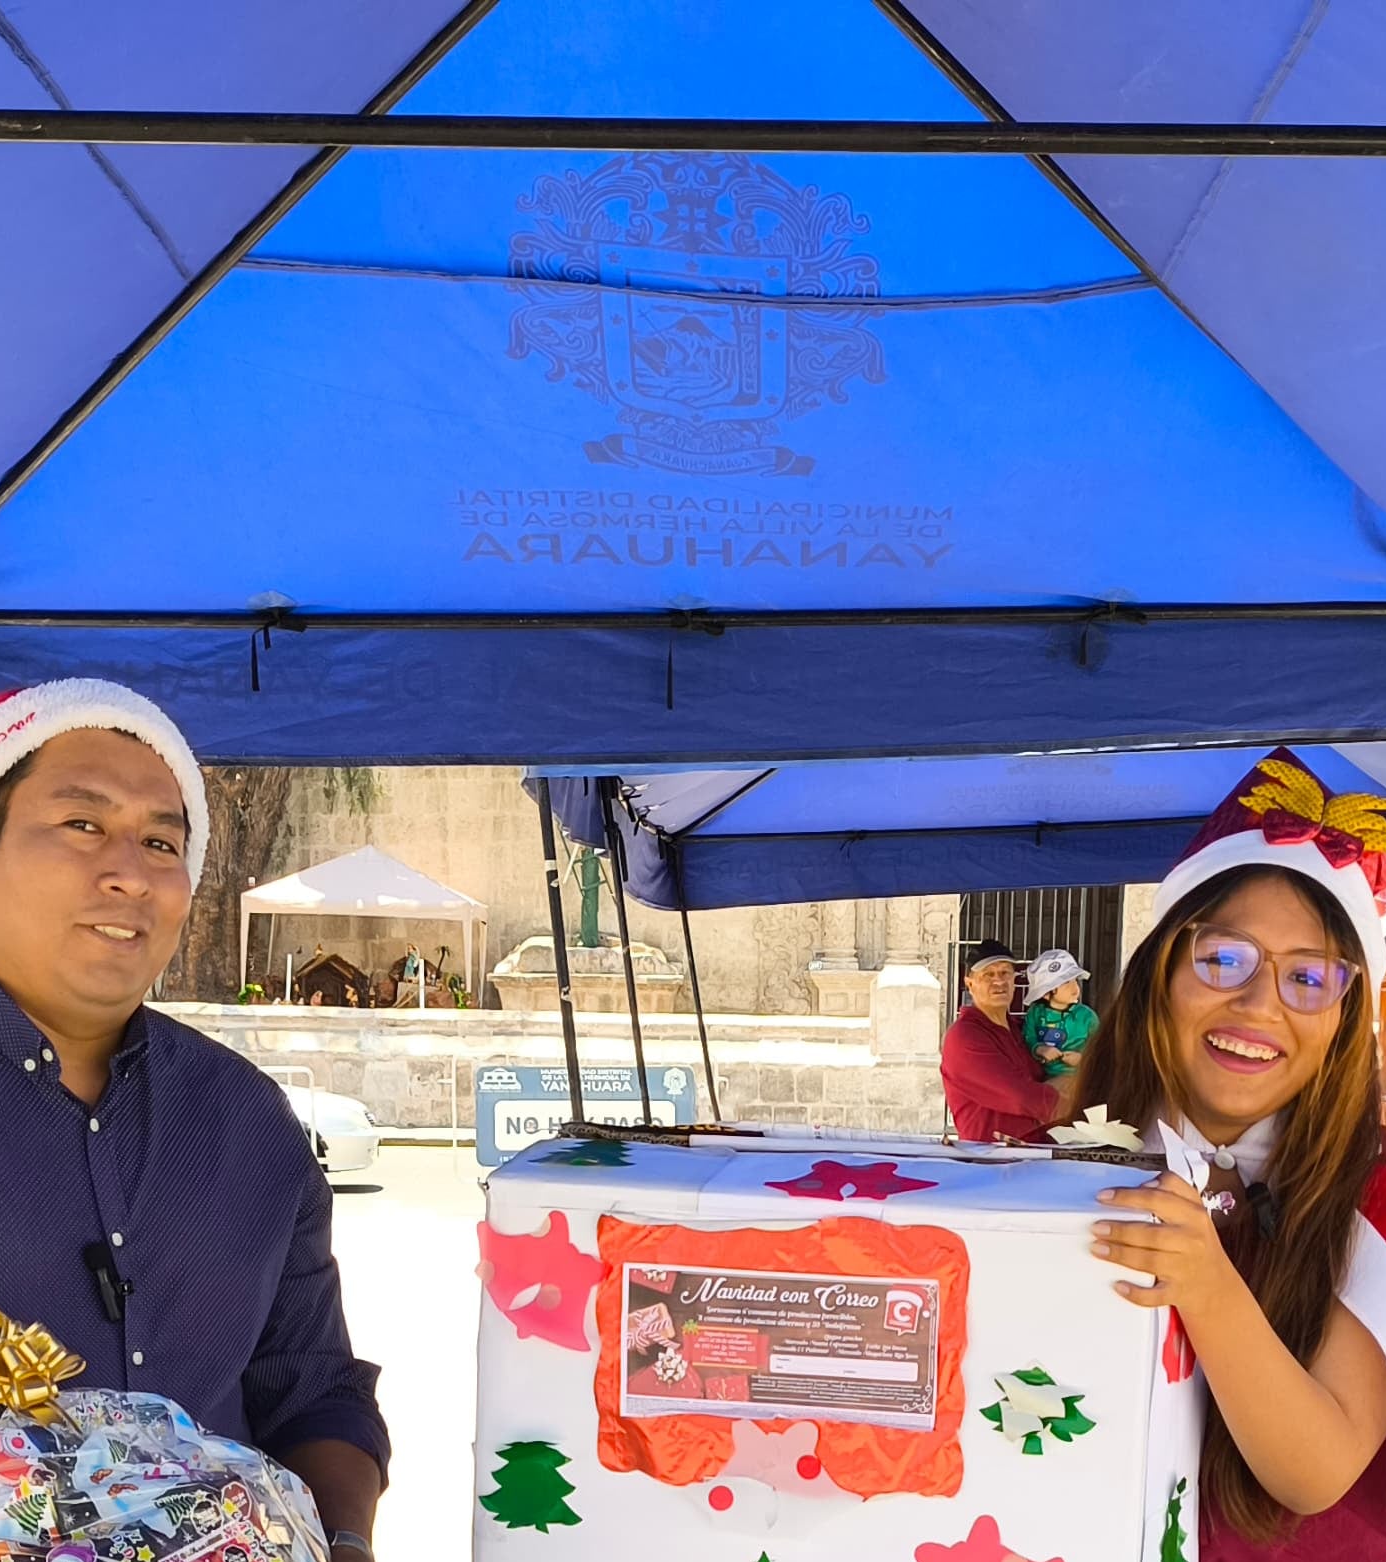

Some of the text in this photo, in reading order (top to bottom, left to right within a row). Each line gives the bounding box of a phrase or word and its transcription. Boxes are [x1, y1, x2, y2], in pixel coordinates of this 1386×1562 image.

[541, 1081, 632, 1092] YANHUARA
[506, 1117, 539, 1134] NO
[680, 1277, 776, 1304] Navidad
[781, 1289, 809, 1304] con
